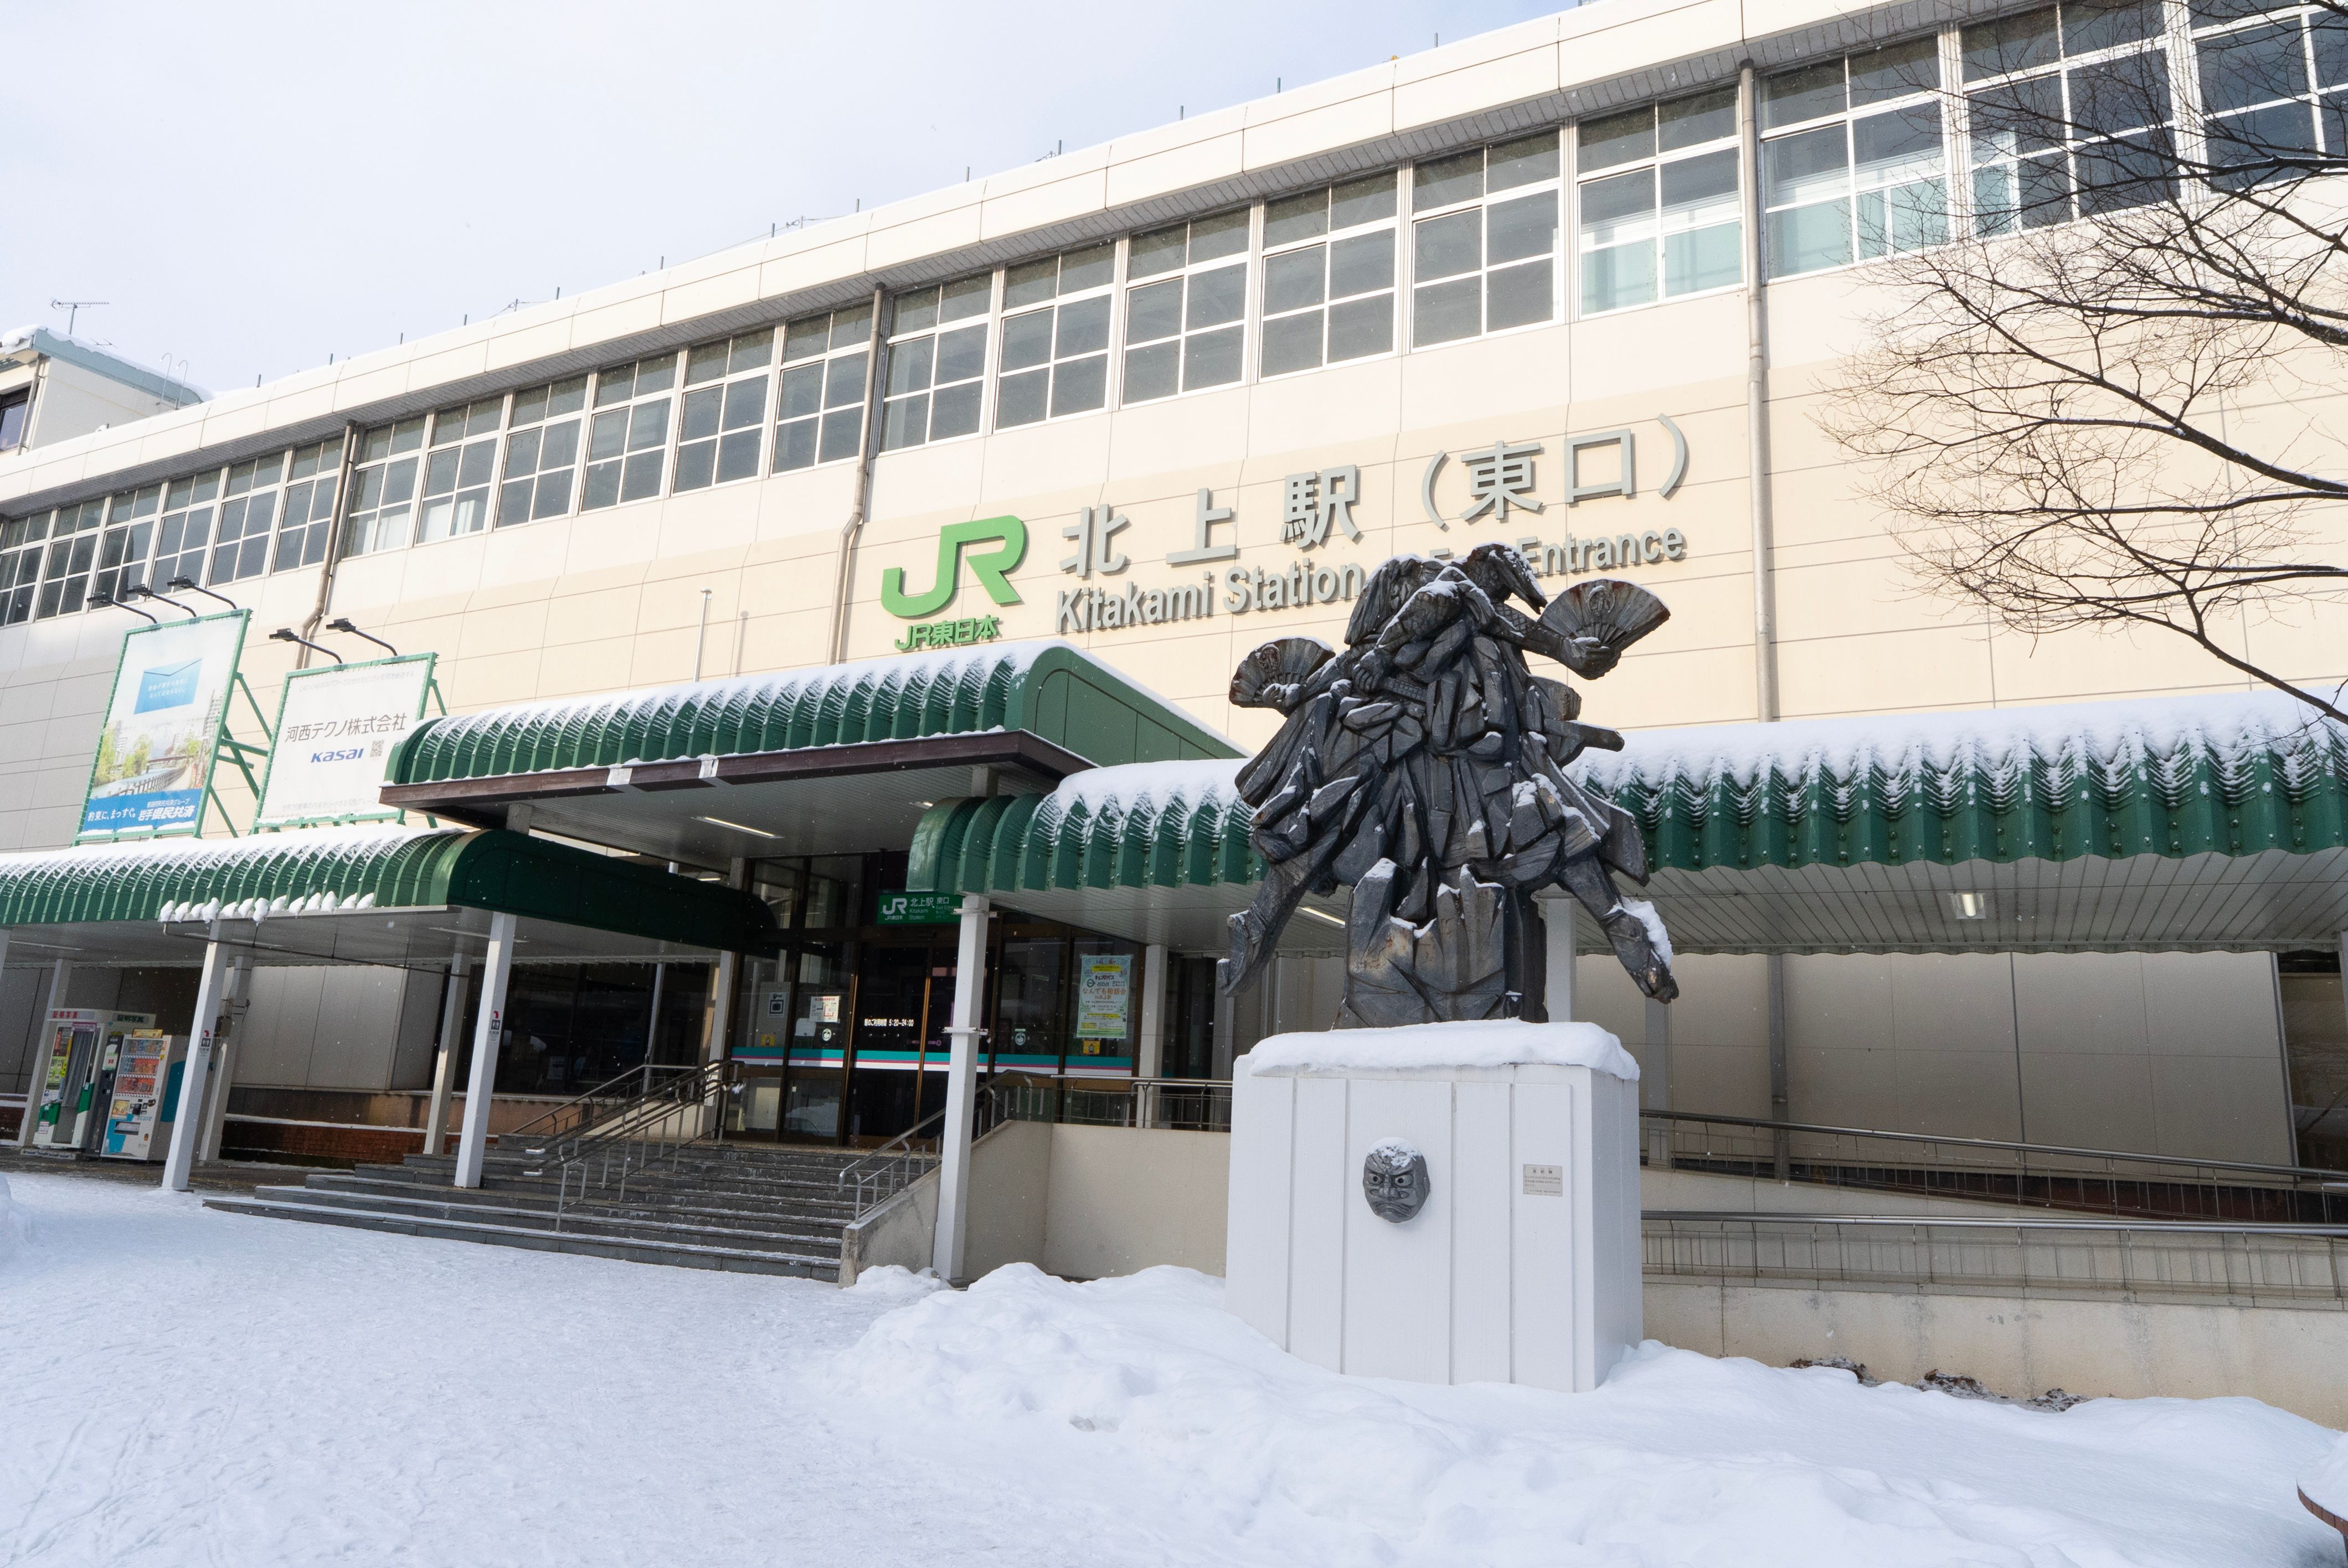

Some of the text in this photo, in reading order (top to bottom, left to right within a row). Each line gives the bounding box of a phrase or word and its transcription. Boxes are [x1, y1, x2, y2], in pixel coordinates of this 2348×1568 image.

[881, 515, 1026, 617] JR
[1055, 527, 1683, 633] Kitakami Station Entrance
[894, 615, 999, 651] JR東日本
[285, 713, 407, 742] 河西テクノ株式会社
[138, 805, 195, 822] 岩手県民共済
[882, 898, 907, 915] JR
[910, 897, 934, 907] 北上駅
